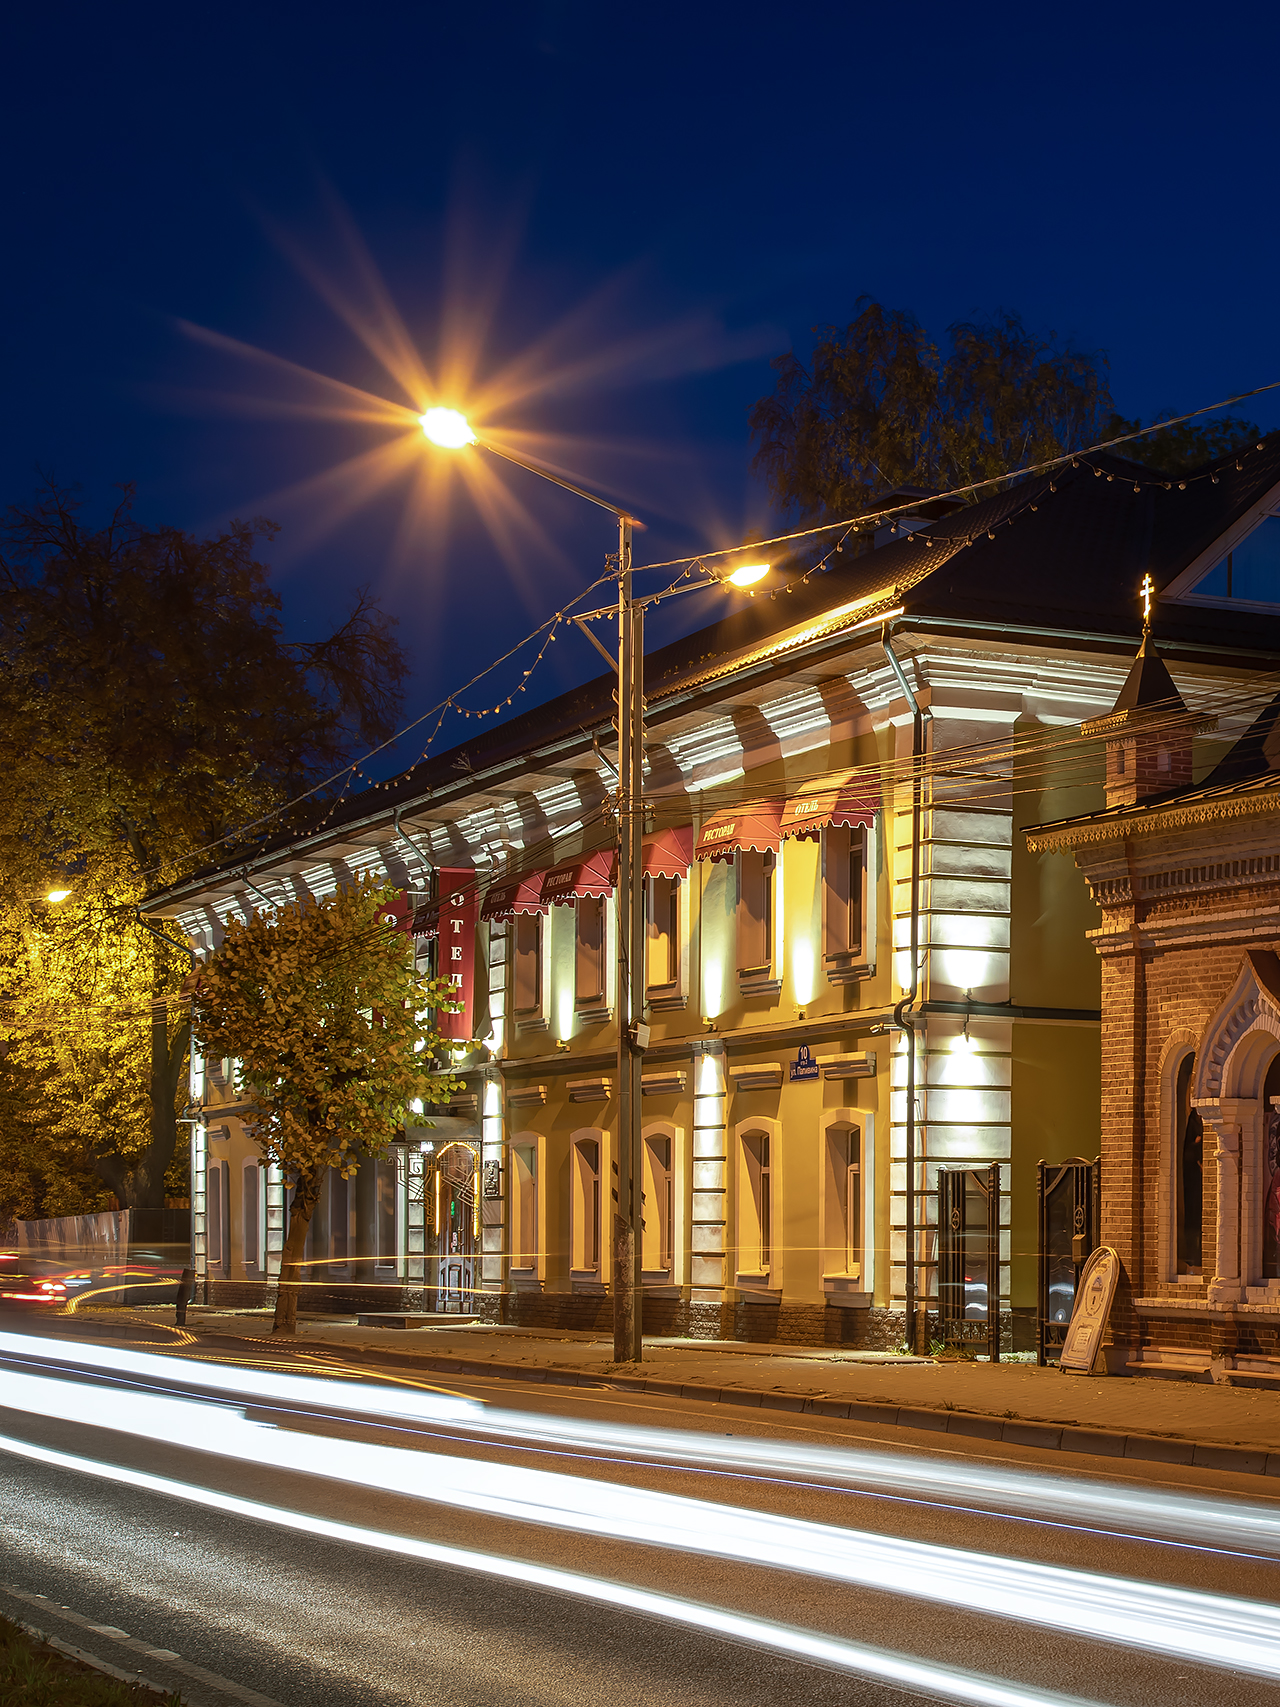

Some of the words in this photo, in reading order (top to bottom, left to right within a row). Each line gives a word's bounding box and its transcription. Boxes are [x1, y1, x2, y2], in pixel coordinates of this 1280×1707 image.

[794, 799, 819, 816] ОТЕЛЬ
[702, 823, 736, 842] РЕСТОРАН
[546, 871, 574, 888] РЕСТОРАН
[800, 1046, 808, 1059] 10
